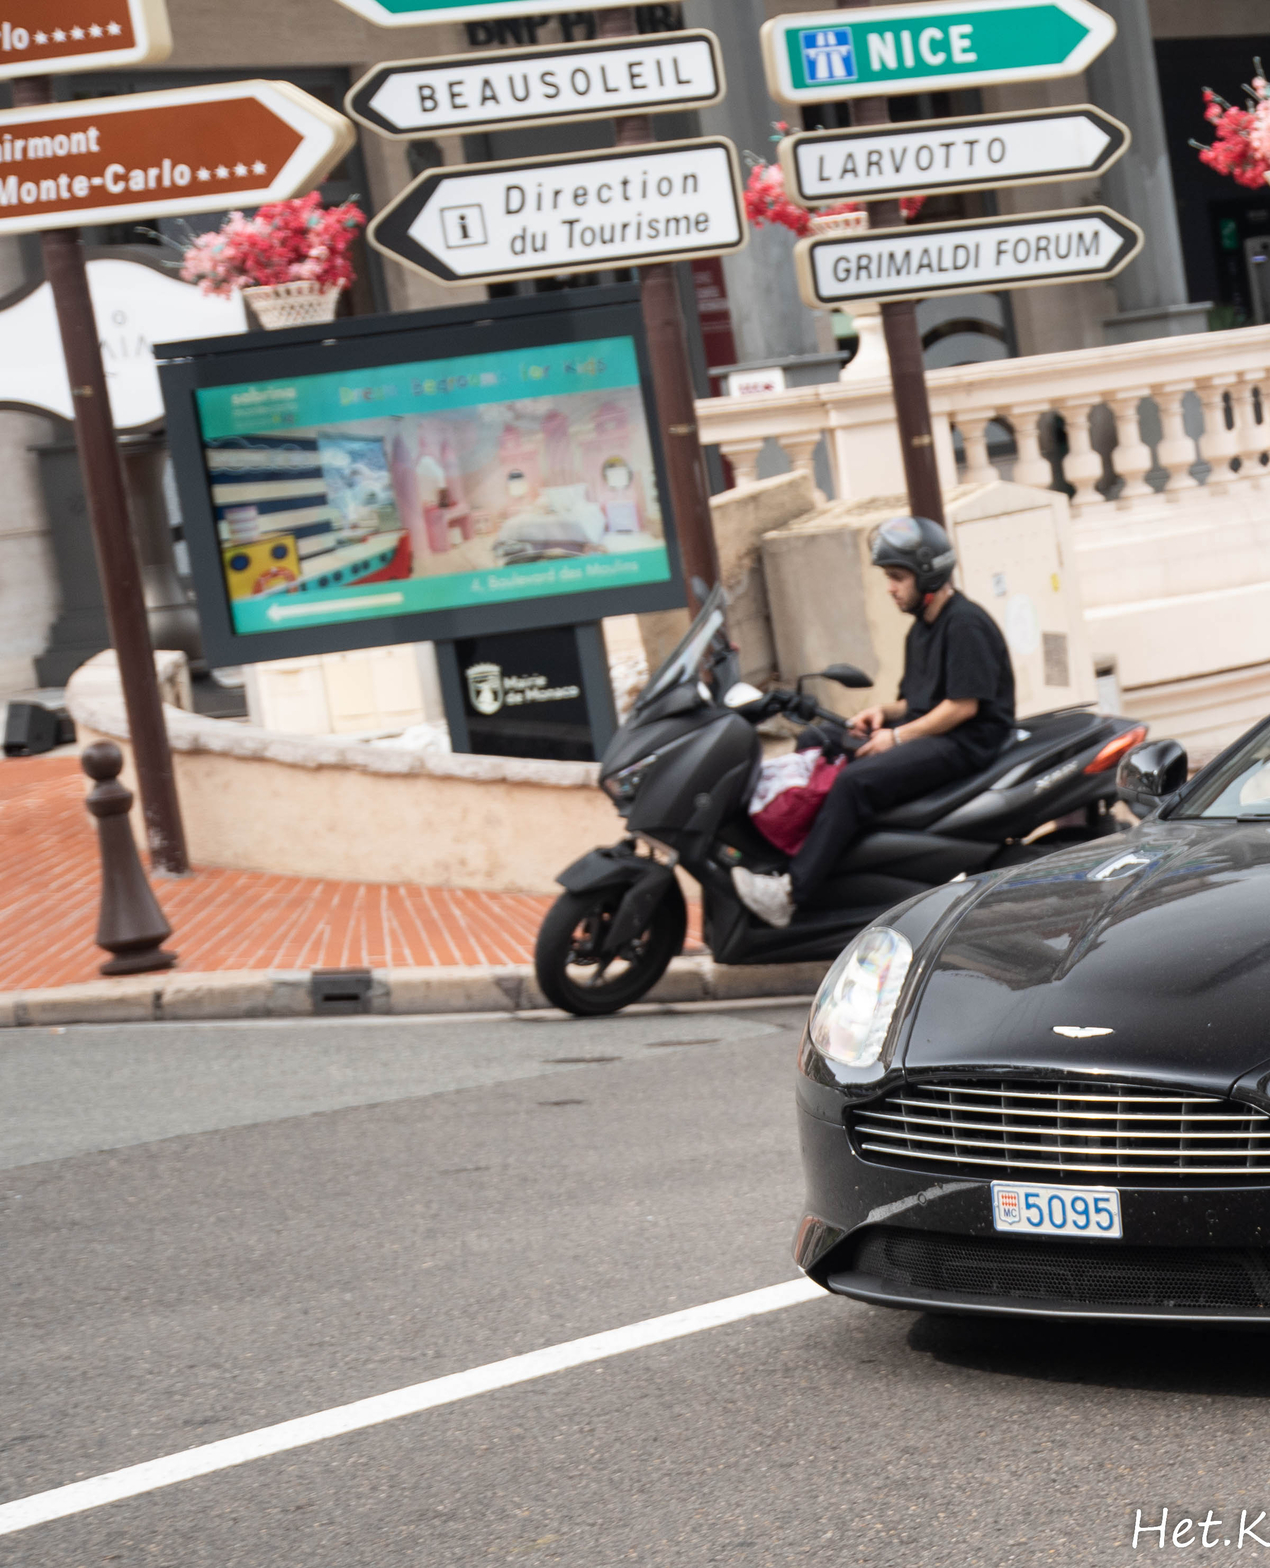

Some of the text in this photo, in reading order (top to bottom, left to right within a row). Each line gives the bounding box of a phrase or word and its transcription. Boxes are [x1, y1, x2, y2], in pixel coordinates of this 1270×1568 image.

[866, 24, 978, 72] NICE
[417, 57, 693, 113] BEAUSOLEIL
[818, 137, 1007, 182] LARVOTTO
[0, 158, 192, 206] Monte-Carlo
[505, 171, 699, 215] Direction
[511, 212, 710, 256] du Tourisme
[833, 231, 1101, 283] GRIMALDI FORUM
[503, 673, 548, 690] Mairie
[505, 685, 580, 706] de Monaco
[1003, 1191, 1114, 1231] MC 5095
